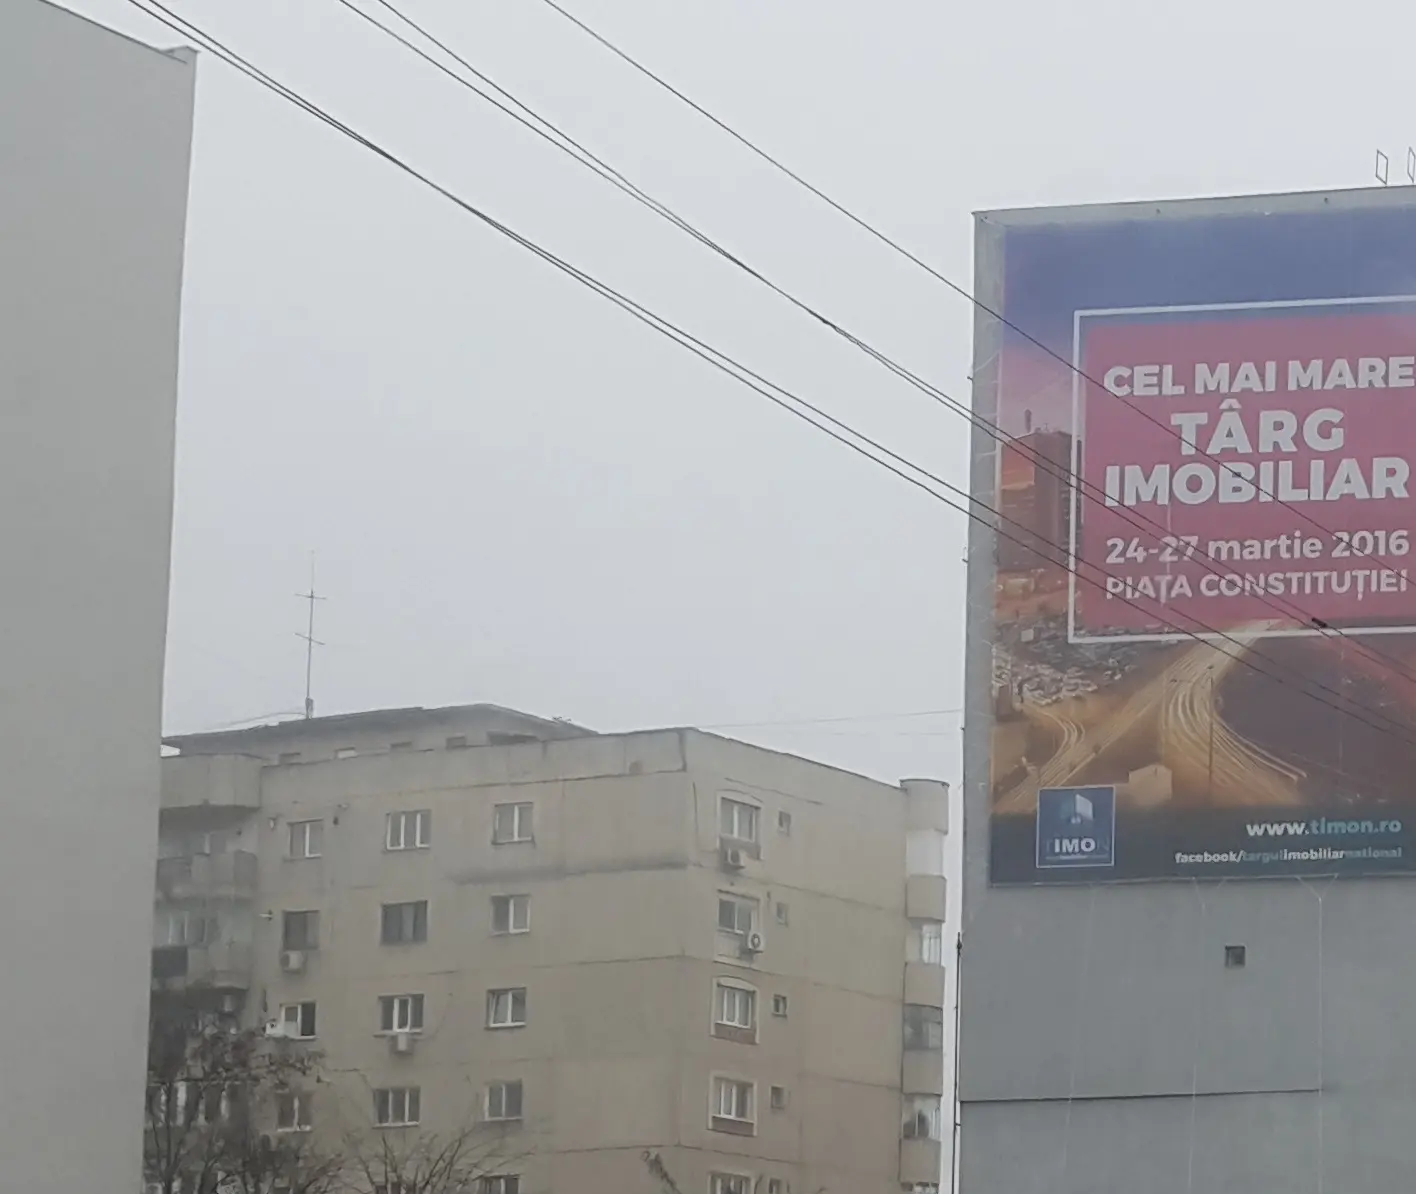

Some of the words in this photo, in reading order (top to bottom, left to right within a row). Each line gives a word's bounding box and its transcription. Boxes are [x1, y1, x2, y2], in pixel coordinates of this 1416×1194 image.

[1104, 364, 1185, 397] CEL
[1195, 361, 1277, 394] MAI
[1287, 356, 1415, 391] MARE
[1171, 398, 1345, 455] TÂRG
[1104, 457, 1410, 507] IMOBILIAR
[1106, 535, 1199, 564] 24-27
[1208, 531, 1323, 561] martie
[1331, 530, 1410, 558] 2016
[1246, 816, 1402, 836] www.timon.ro
